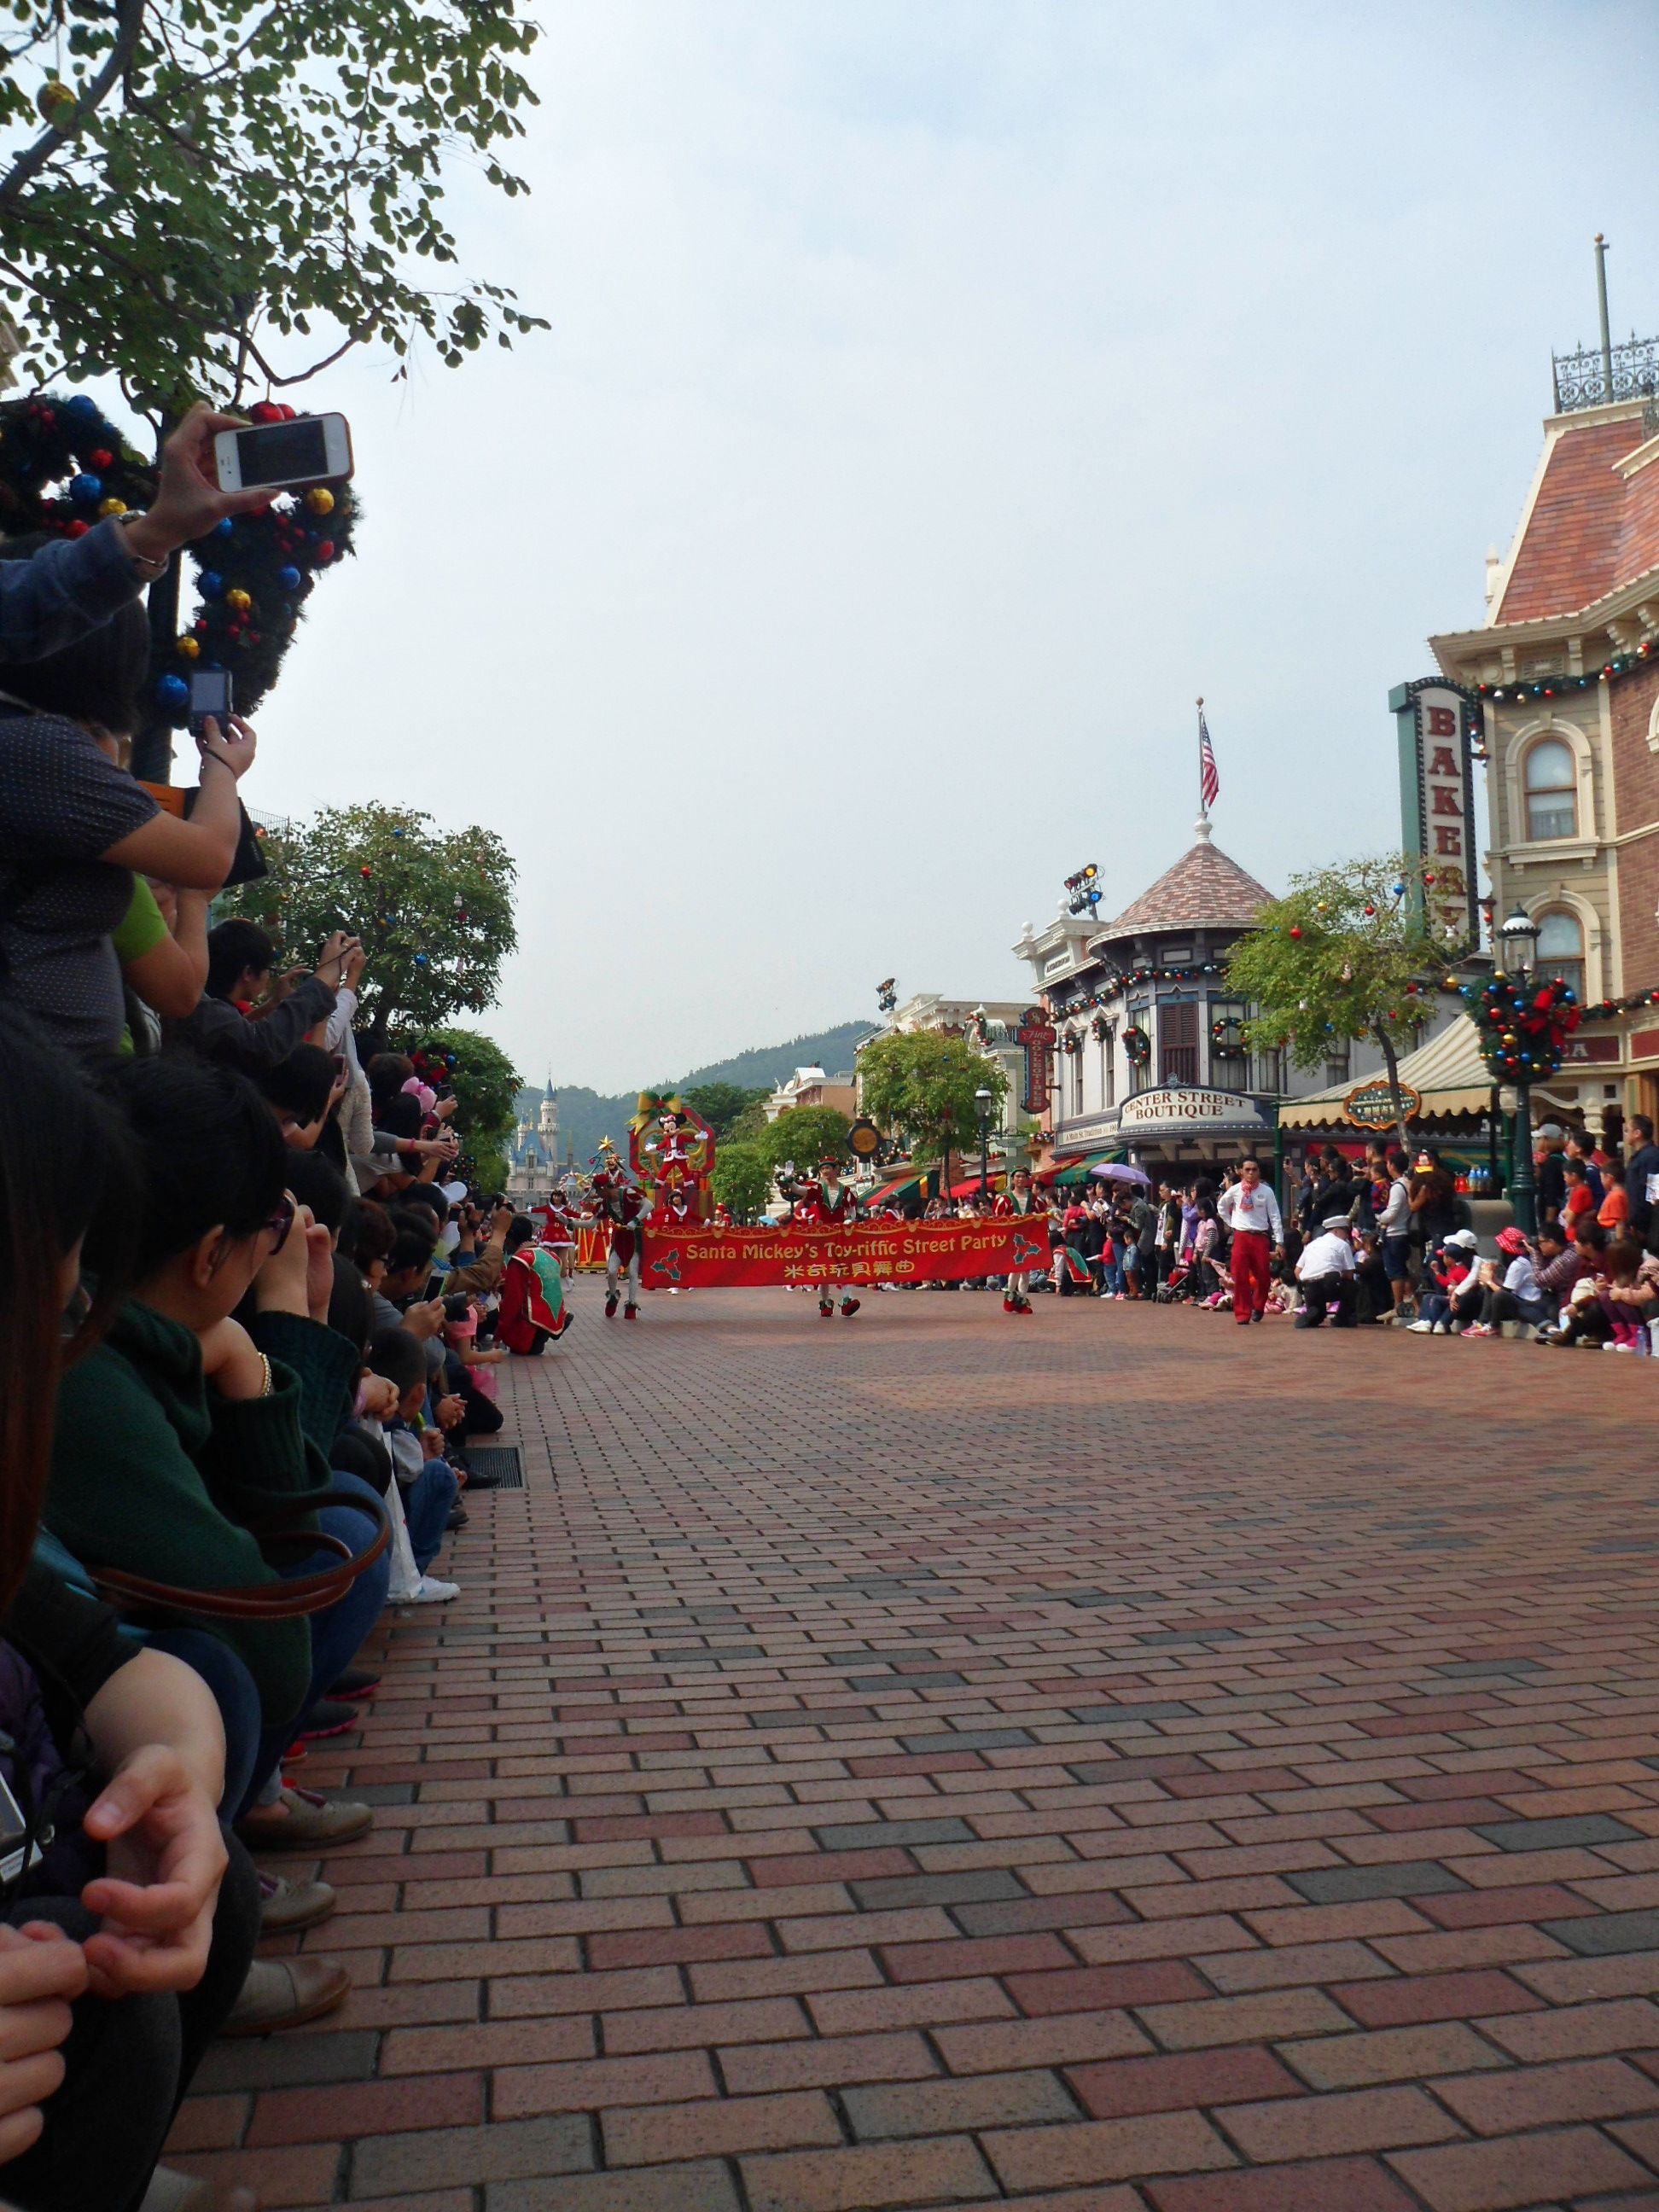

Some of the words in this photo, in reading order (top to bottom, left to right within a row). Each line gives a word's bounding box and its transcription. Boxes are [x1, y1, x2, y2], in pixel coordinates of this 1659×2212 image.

[1125, 1091, 1172, 1113] CENTER
[1178, 1091, 1245, 1108] STREET
[1136, 1104, 1223, 1120] BOUTIQUE
[686, 1243, 736, 1260] Santa
[742, 1243, 818, 1260] Mickey's
[824, 1240, 897, 1258] Toy-riffic
[903, 1237, 956, 1254] Street
[960, 1233, 1007, 1250] Party
[784, 1260, 915, 1278] 米奇玩具舞曲
